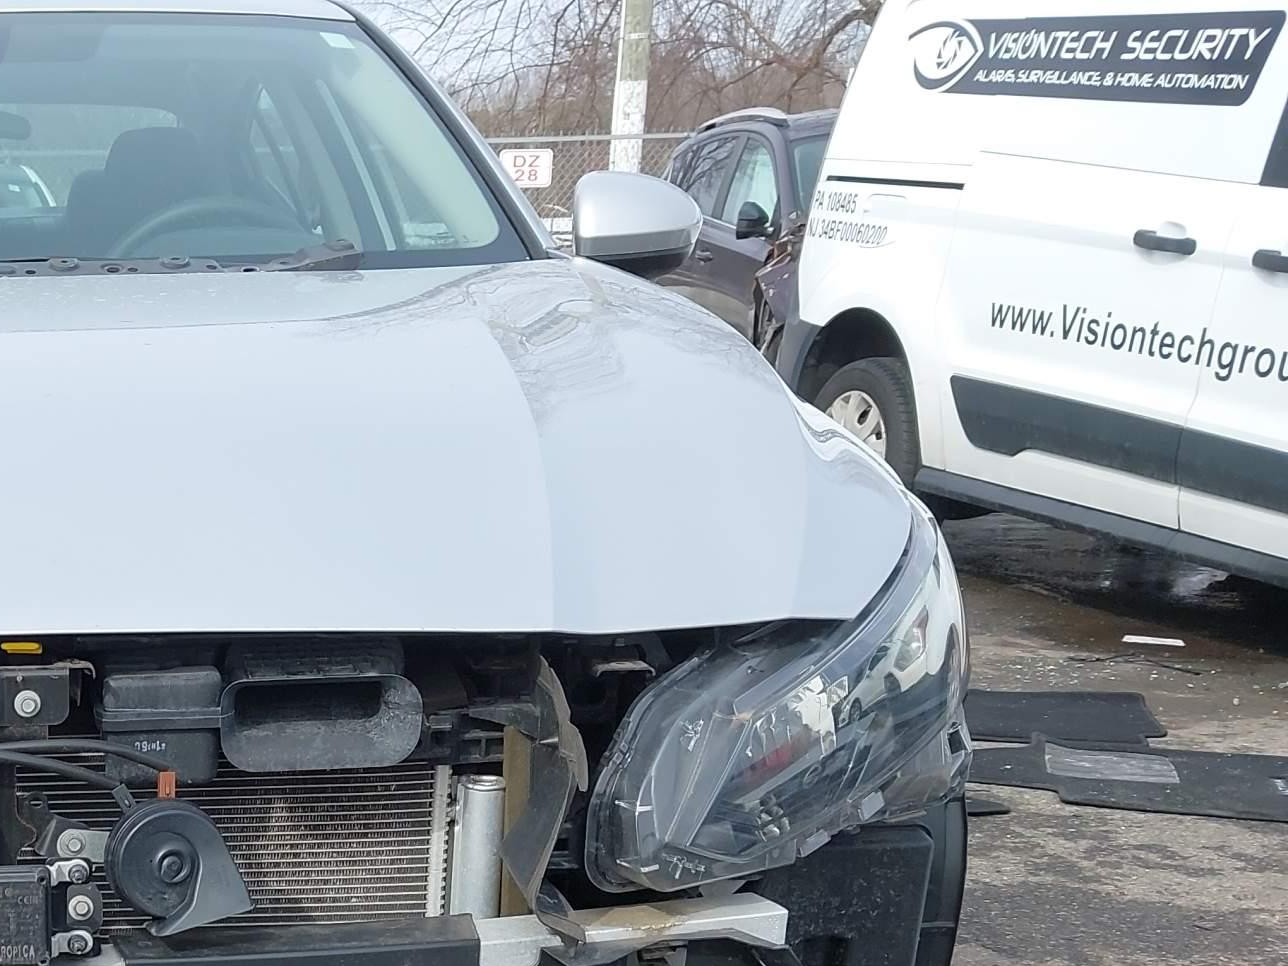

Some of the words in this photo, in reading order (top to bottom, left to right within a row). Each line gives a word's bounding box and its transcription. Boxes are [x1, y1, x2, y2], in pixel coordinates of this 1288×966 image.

[987, 28, 1118, 60] VISIONTECH
[1120, 28, 1272, 60] SECURITY
[1103, 72, 1114, 86] &
[1114, 72, 1154, 87] HOME
[1153, 73, 1250, 89] AUTOMATION
[513, 155, 540, 168] DZ
[514, 169, 538, 183] 28
[813, 190, 826, 210] PA
[826, 191, 859, 213] 108485
[807, 217, 819, 237] NJ
